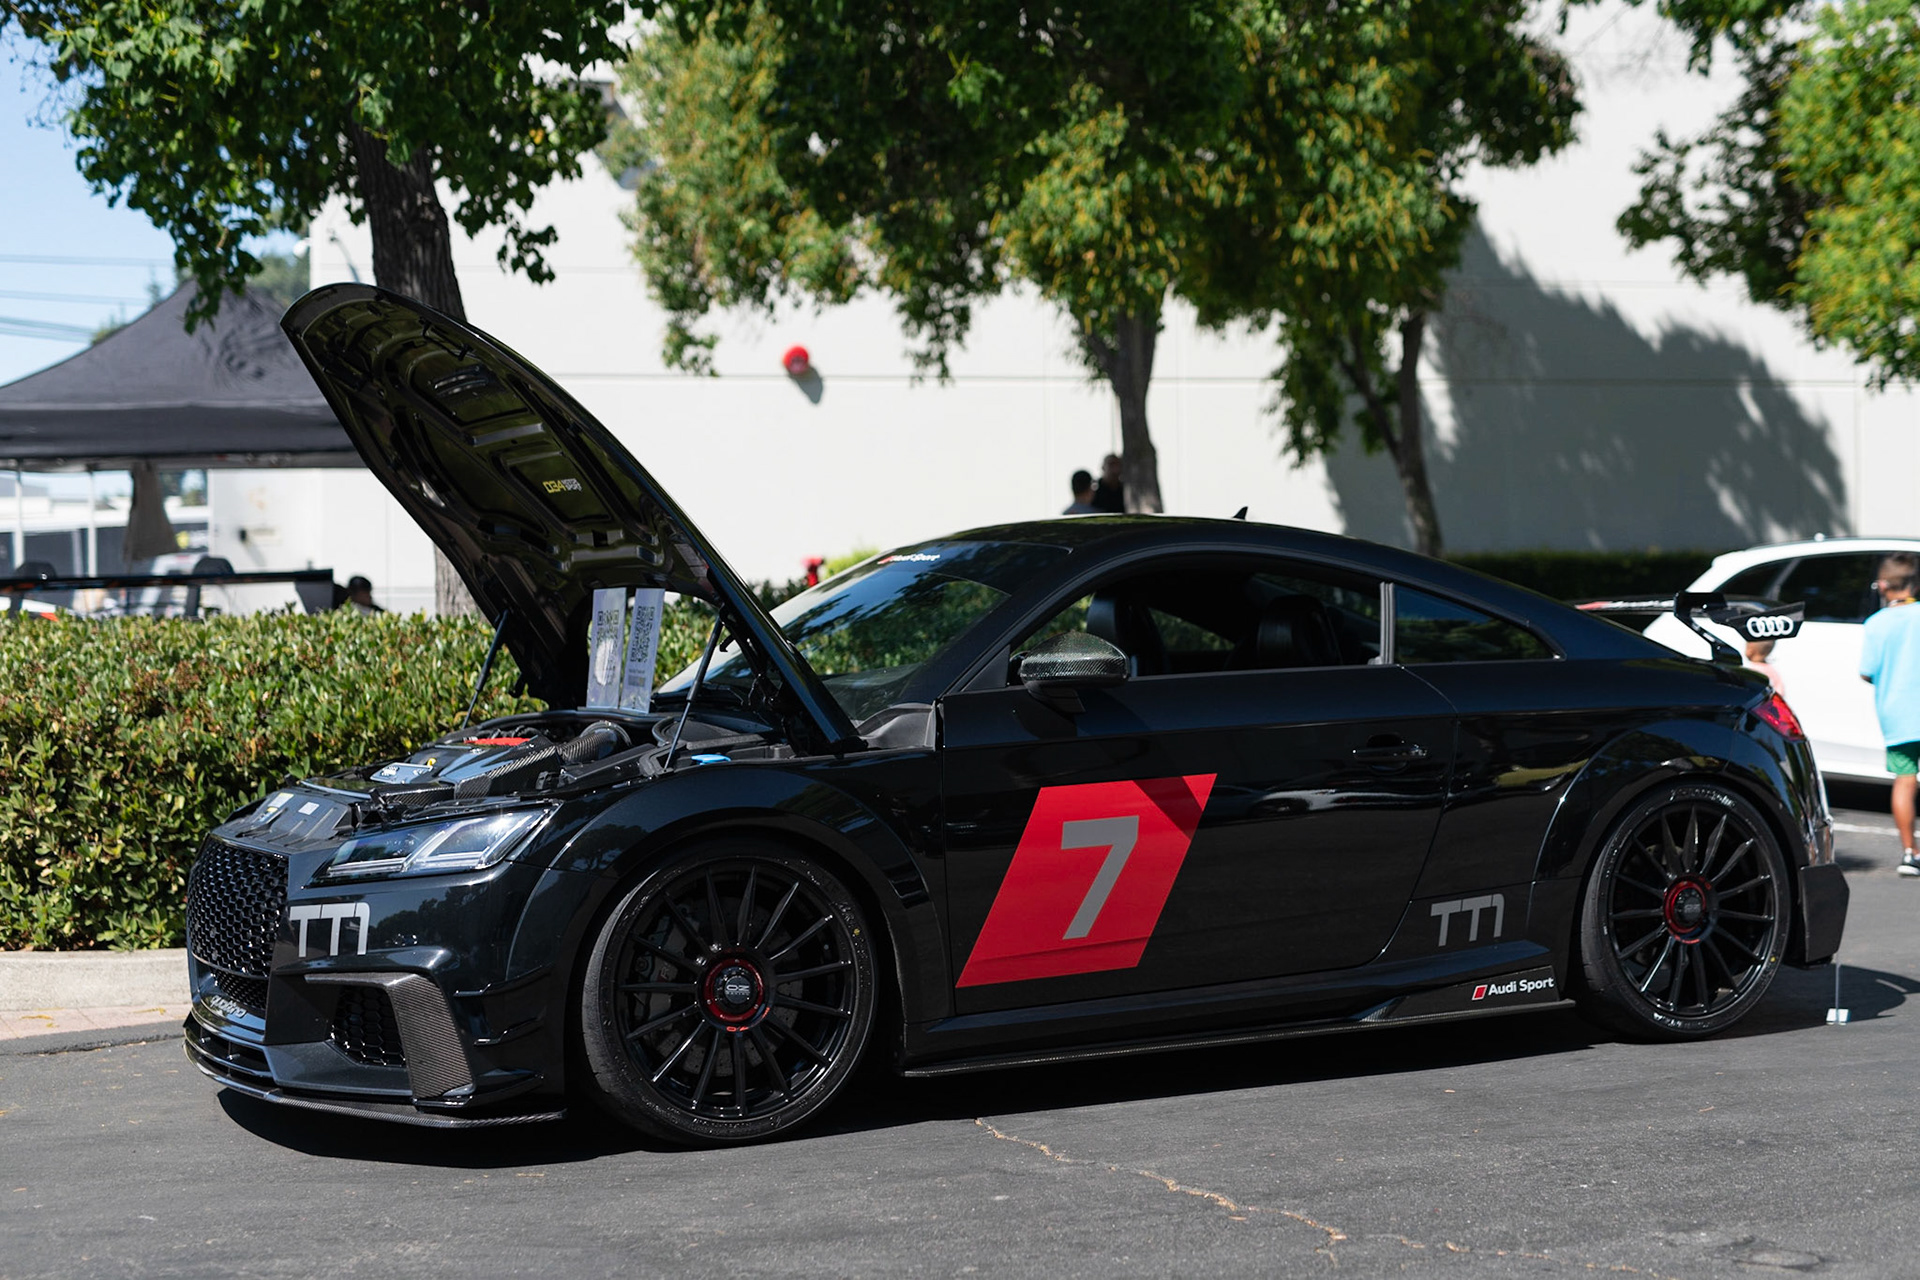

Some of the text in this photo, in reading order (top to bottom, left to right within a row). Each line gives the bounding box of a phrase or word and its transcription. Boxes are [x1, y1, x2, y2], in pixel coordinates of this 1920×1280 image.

[1061, 815, 1140, 940] 7
[726, 984, 750, 992] OZ
[1488, 977, 1554, 996] Audi Sport
[210, 994, 247, 1018] quattro
